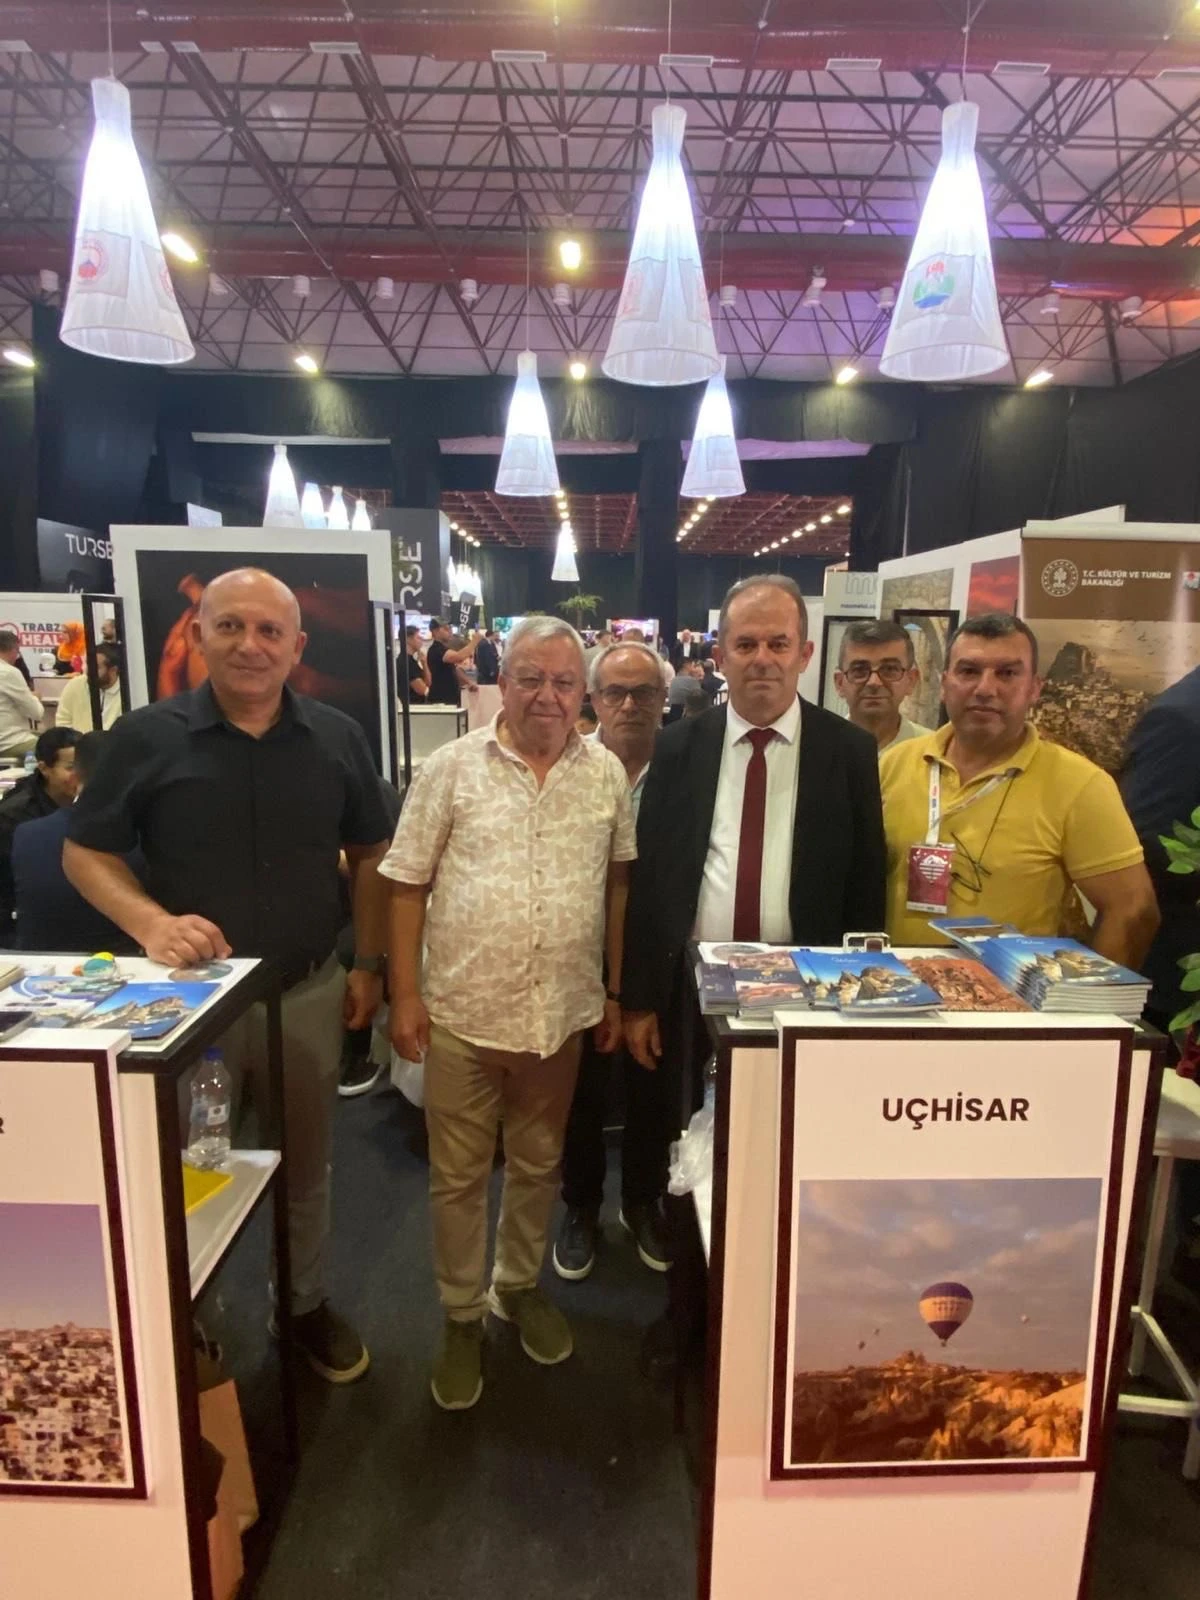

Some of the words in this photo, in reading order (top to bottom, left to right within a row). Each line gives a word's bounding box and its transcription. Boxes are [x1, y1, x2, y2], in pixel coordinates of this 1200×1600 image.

[1097, 569, 1127, 578] KÜLTÜR
[1129, 571, 1138, 579] VE
[1142, 570, 1171, 580] TURİZM
[1081, 578, 1124, 587] BAKANLIĞI
[882, 1092, 1030, 1130] UÇHİSAR
